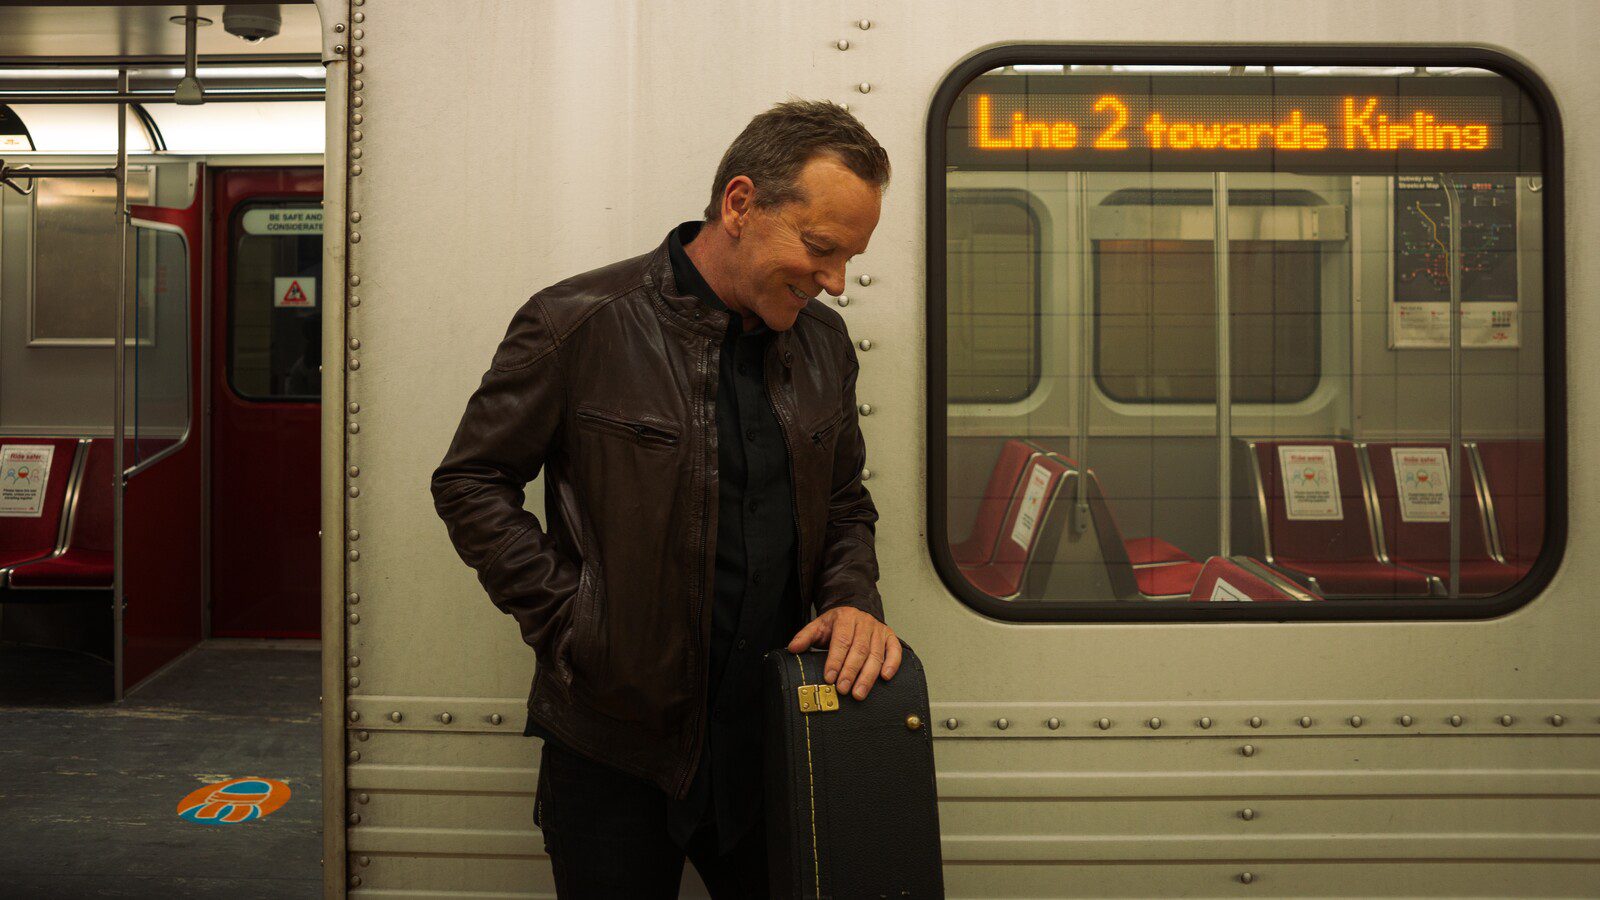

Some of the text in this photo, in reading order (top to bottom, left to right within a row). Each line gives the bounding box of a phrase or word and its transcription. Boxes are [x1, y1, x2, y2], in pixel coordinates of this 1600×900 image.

[977, 94, 1488, 150] Line 2 towards Kipling
[267, 223, 323, 231] CONSIDERATE
